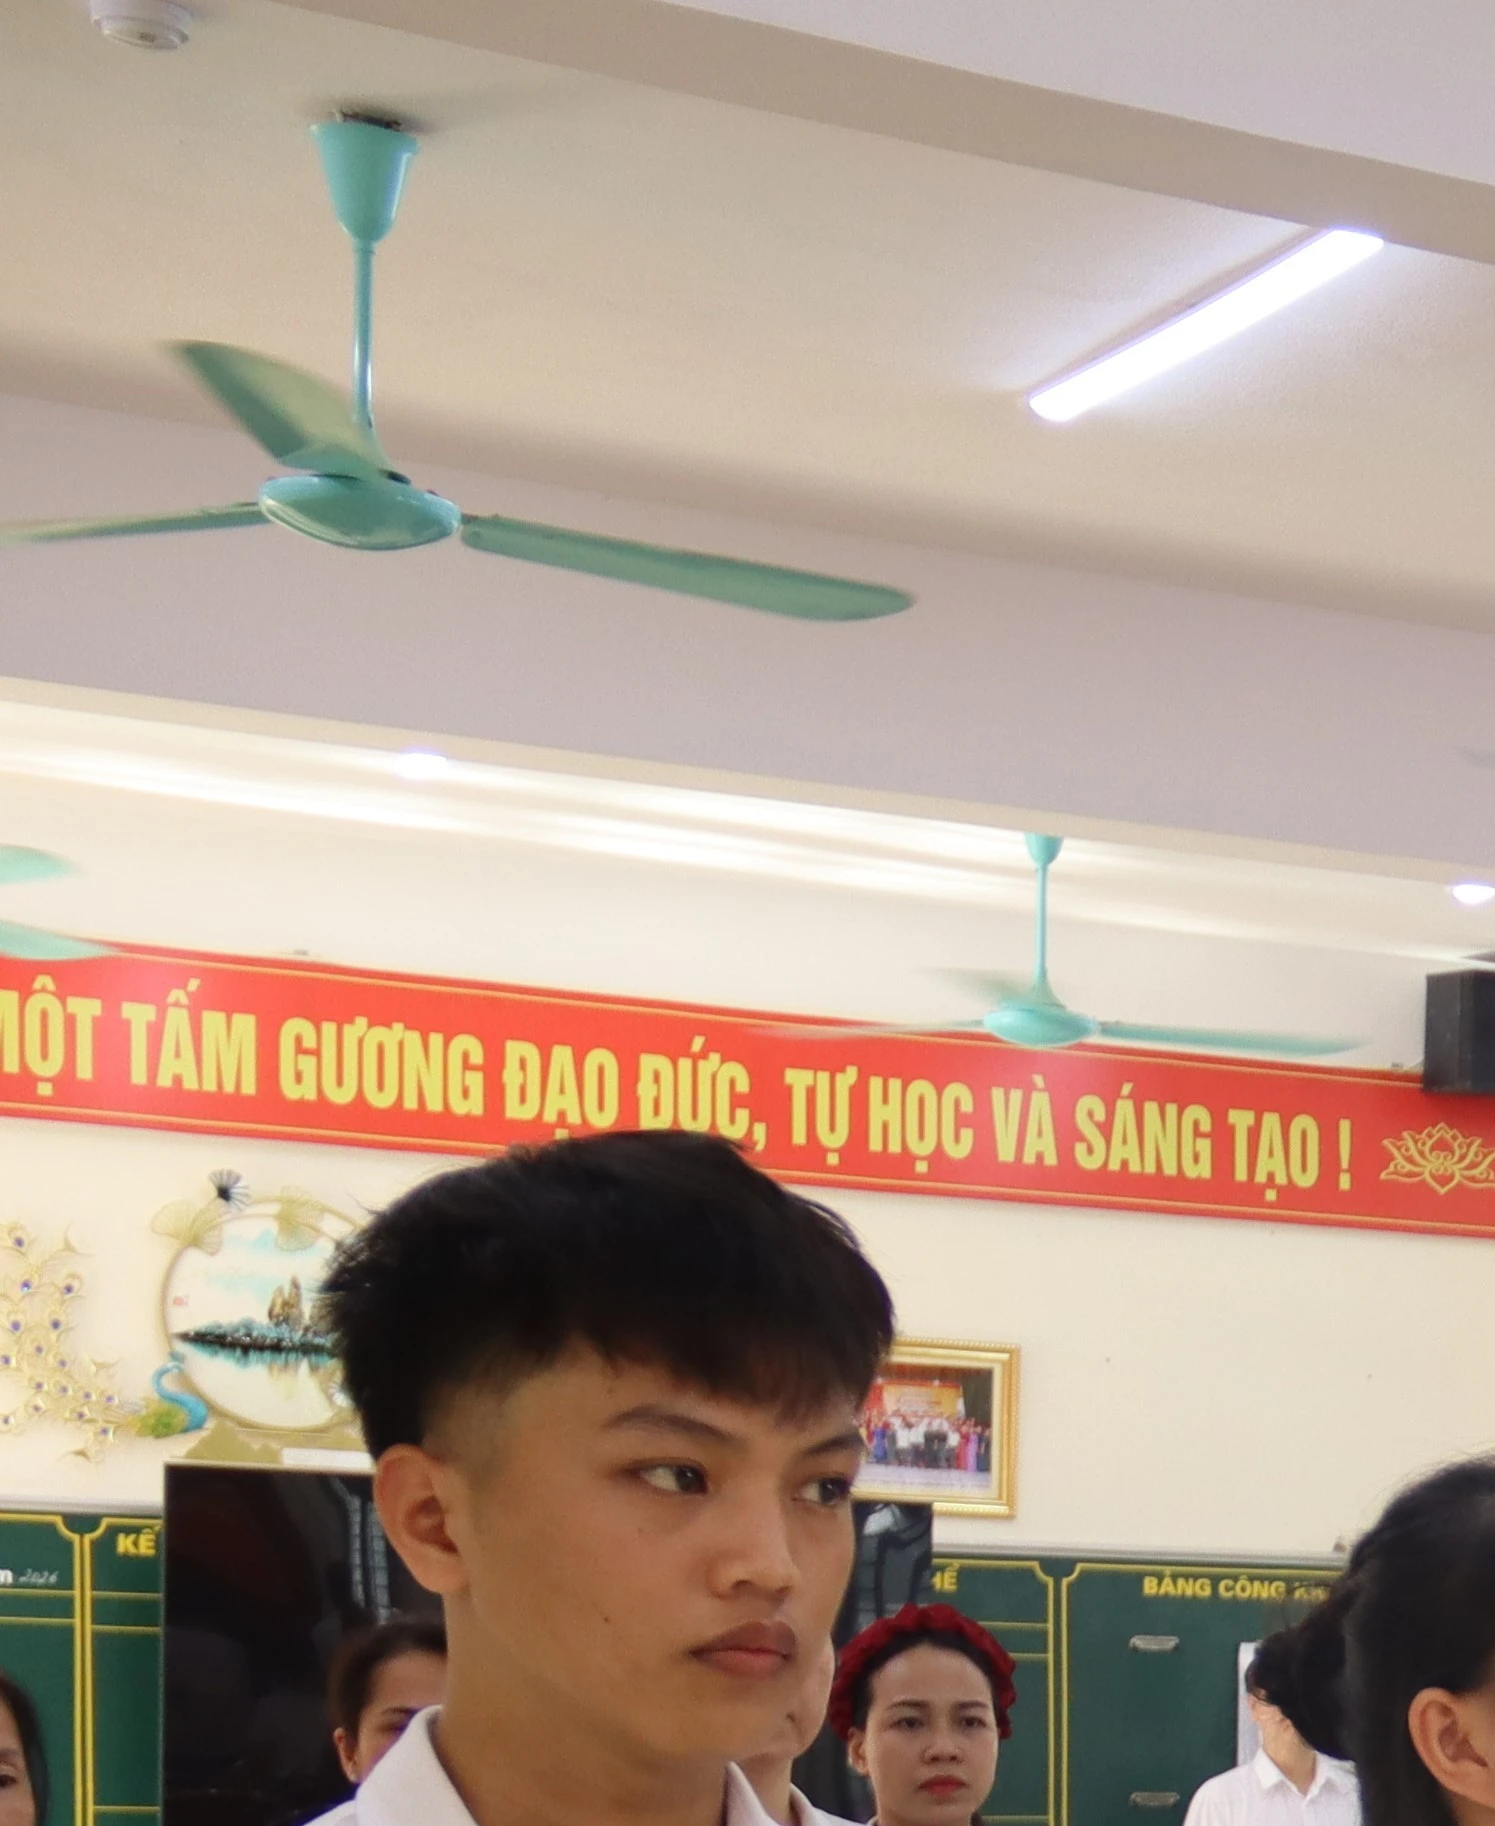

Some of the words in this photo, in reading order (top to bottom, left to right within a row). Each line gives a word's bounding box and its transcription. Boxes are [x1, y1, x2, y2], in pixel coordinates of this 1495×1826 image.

[121, 978, 257, 1096] TẤM
[279, 1016, 485, 1117] GƯƠNG
[503, 1040, 619, 1139] ĐẠO
[637, 1036, 767, 1152] ĐỨC,
[785, 1065, 858, 1165] TỰ
[868, 1076, 975, 1174] HỌC
[992, 1073, 1058, 1168] VÀ
[1074, 1082, 1212, 1180] SÁNG
[1227, 1109, 1320, 1202] TẠO
[1143, 1569, 1212, 1597] BẢNG
[1218, 1574, 1287, 1600] CÔNG
